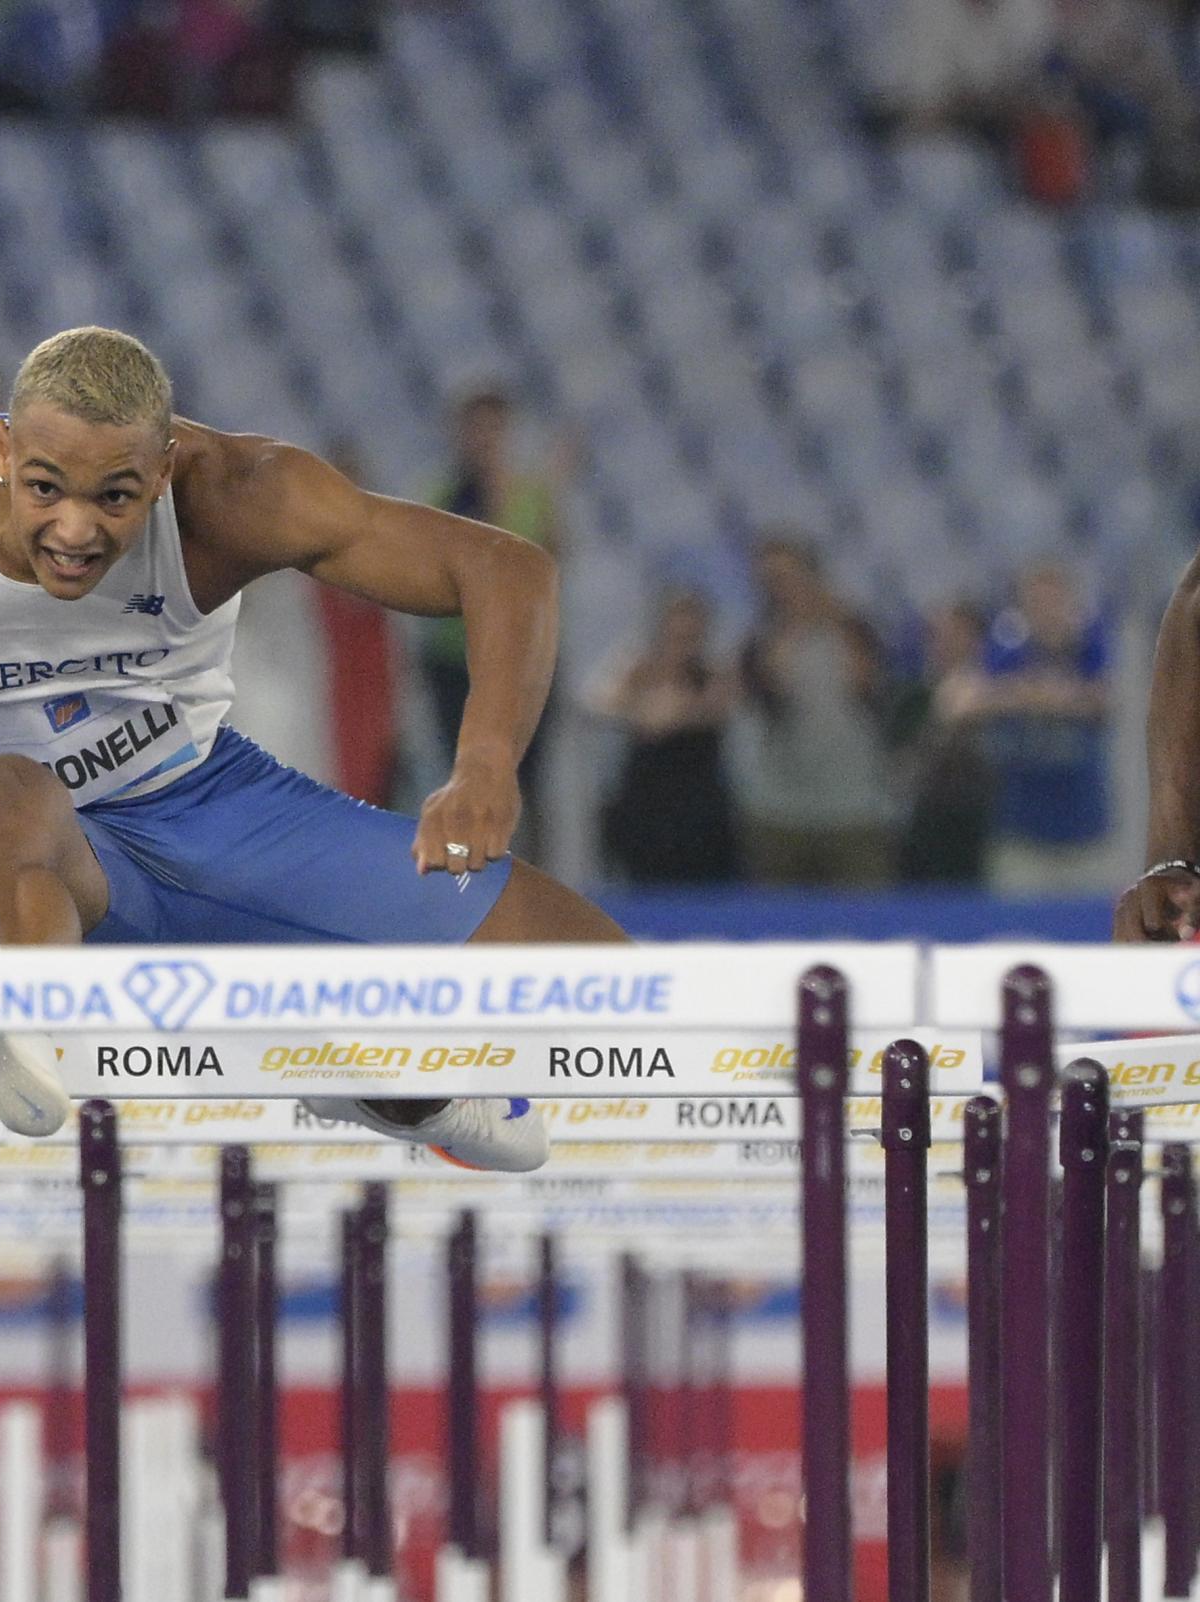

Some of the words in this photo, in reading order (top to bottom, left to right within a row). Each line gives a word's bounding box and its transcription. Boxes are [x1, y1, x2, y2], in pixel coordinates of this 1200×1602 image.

[42, 703, 178, 790] ONELLI
[224, 977, 463, 1019] DIAMOND
[477, 973, 674, 1016] LEAGUE
[97, 1046, 224, 1077] ROMA
[258, 1042, 413, 1072] golden
[417, 1042, 517, 1072] gala
[549, 1047, 675, 1078] ROMA
[676, 1101, 785, 1127] ROMA
